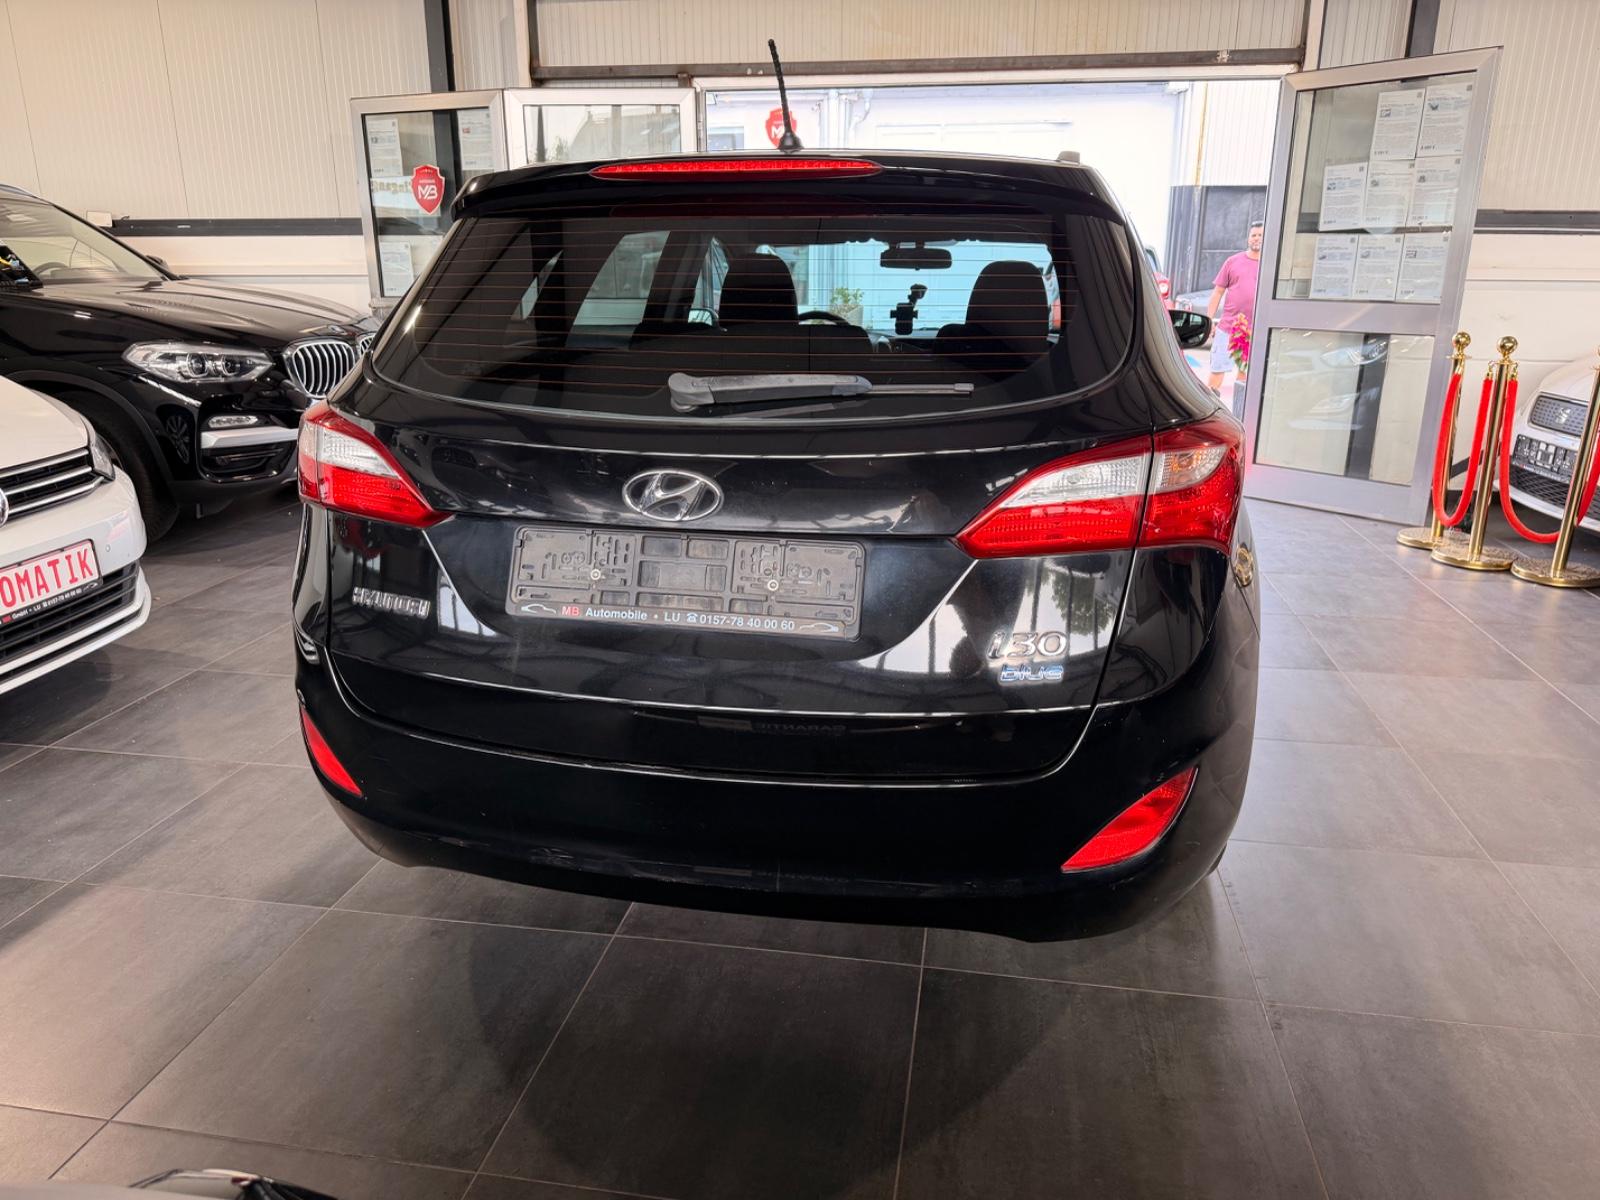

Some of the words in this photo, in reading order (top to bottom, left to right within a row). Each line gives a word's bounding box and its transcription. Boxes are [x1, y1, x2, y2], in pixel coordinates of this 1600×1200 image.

[418, 184, 438, 200] MB
[0, 548, 93, 608] OMATIK
[562, 606, 580, 616] MB
[585, 607, 648, 621] Automobile
[664, 611, 681, 622] LU
[699, 614, 744, 627] 0157-78
[747, 617, 761, 628] 40
[764, 618, 778, 630] 00
[780, 620, 795, 631] 60
[987, 630, 1068, 659] i30
